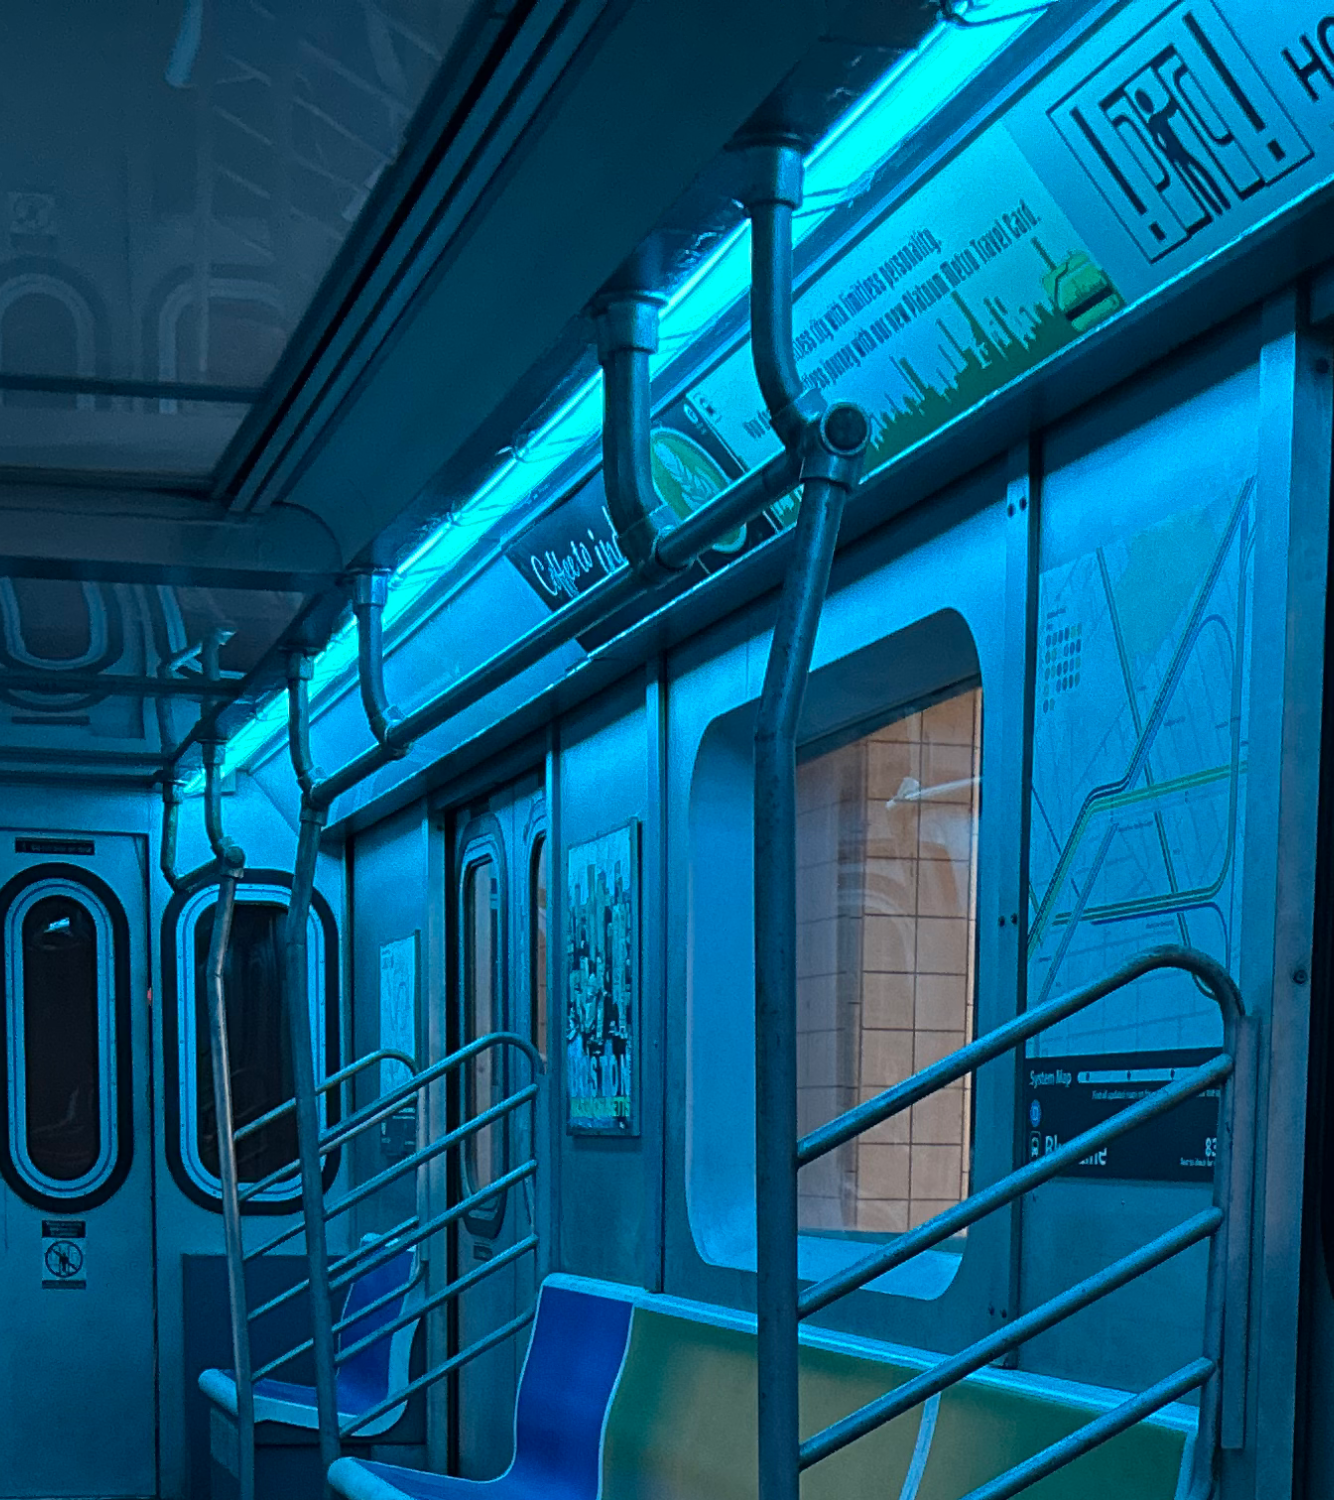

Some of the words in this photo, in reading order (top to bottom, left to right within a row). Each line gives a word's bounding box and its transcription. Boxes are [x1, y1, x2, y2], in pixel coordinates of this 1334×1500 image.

[824, 302, 851, 331] with
[878, 227, 943, 291] personality.
[851, 326, 878, 358] with
[884, 302, 912, 332] new
[939, 248, 981, 288] Metro
[969, 218, 1013, 265] Travel
[1001, 198, 1042, 240] Card.
[570, 540, 593, 574] to
[1028, 1070, 1055, 1088] System
[1055, 1068, 1072, 1087] Map
